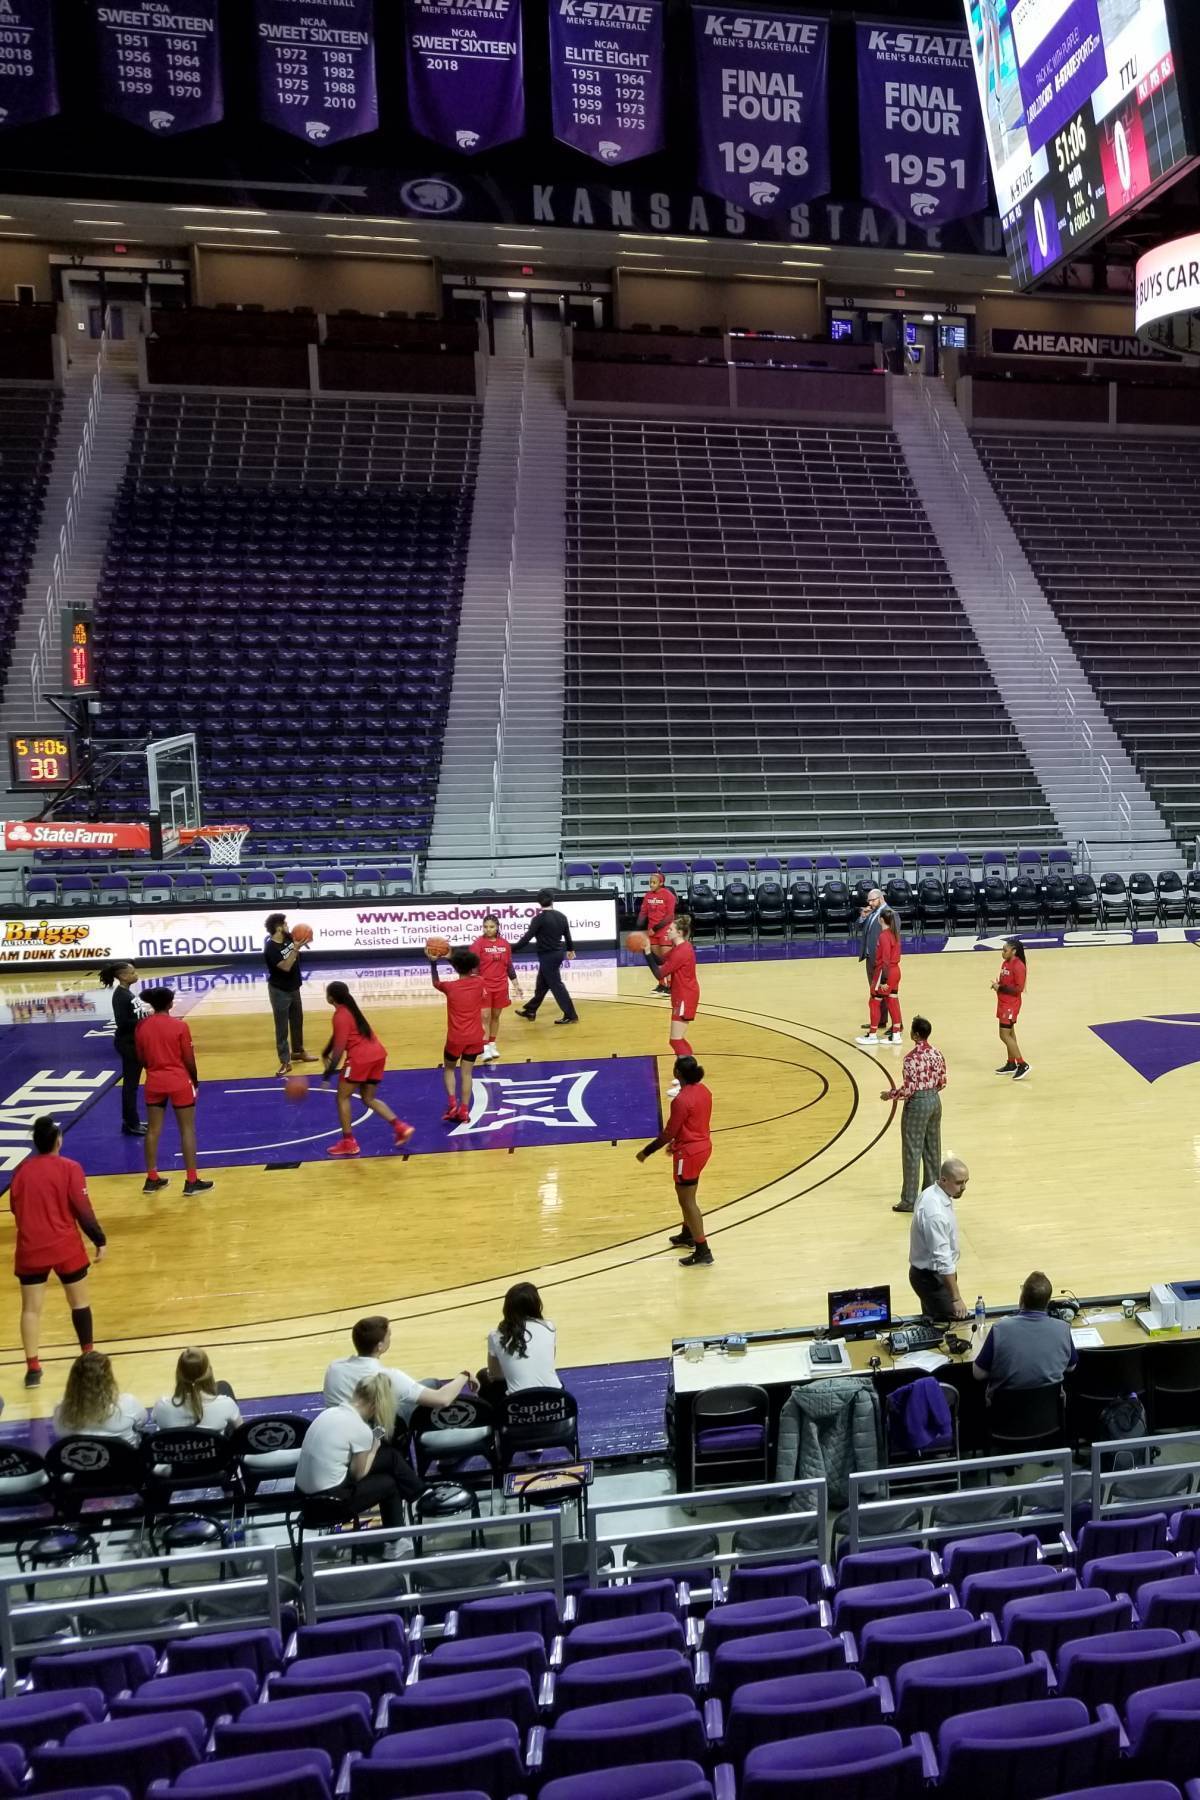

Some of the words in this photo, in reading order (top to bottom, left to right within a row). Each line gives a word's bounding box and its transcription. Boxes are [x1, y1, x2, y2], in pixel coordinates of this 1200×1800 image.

[141, 3, 170, 13] NCAA
[451, 8, 505, 19] BASKETBALL
[559, 0, 653, 23] K-STATE
[98, 8, 150, 26] SWEET
[152, 14, 214, 32] SIXTEEN
[300, 17, 327, 27] NCAA
[566, 17, 593, 26] MEN'S
[594, 20, 647, 31] BASKETBALL
[258, 23, 308, 40] SWEET
[310, 30, 369, 45] SIXTEEN
[451, 28, 477, 38] NCAA
[703, 15, 819, 45] K-STATE
[115, 33, 148, 47] 1951
[165, 38, 198, 52] 1961
[412, 35, 460, 51] SWEET
[461, 39, 516, 55] SIXTEEN
[594, 40, 619, 50] NCAA
[713, 37, 744, 49] MEN'S
[747, 40, 810, 54] BASKETBALL
[117, 49, 151, 63] 1956
[166, 54, 200, 67] 1964
[275, 47, 308, 61] 1972
[322, 51, 353, 64] 1981
[427, 58, 458, 71] 2018
[565, 46, 604, 62] ELITE
[606, 51, 649, 67] EIGHT
[877, 51, 906, 63] MEN'S
[909, 54, 969, 68] BASKETBALL
[0, 64, 33, 76] 2019
[118, 65, 152, 78] 1958
[167, 69, 201, 82] 1968
[276, 62, 308, 76] 1973
[323, 66, 355, 79] 1982
[571, 68, 601, 82] 1951
[615, 73, 645, 86] 1964
[1120, 55, 1138, 90] TTU
[119, 80, 152, 94] 1959
[168, 85, 201, 98] 1970
[276, 77, 309, 91] 1975
[324, 81, 356, 94] 1988
[572, 83, 602, 96] 1958
[615, 88, 645, 101] 1972
[722, 68, 803, 98] FINAL
[277, 92, 309, 106] 1977
[323, 96, 356, 110] 2010
[885, 81, 962, 112] FINAL
[572, 98, 602, 111] 1959
[616, 103, 645, 115] 1973
[722, 94, 802, 123] FOUR
[573, 112, 602, 126] 1961
[616, 117, 645, 130] 1975
[885, 106, 960, 136] FOUR
[1055, 114, 1087, 172] 51:06
[718, 141, 809, 176] 1948
[1114, 120, 1131, 191] 0
[885, 153, 966, 189] 1951
[1010, 166, 1033, 202] K-STATE
[1074, 190, 1084, 209] TOL
[533, 184, 746, 235] KANSAS
[1034, 197, 1047, 257] 0
[1074, 207, 1090, 232] FOULS
[16, 739, 67, 756] 51:06
[30, 758, 58, 779] 30
[357, 904, 543, 924] www.meadowlark.or
[2, 920, 90, 945] Briggs
[320, 928, 353, 937] Home
[355, 926, 390, 936] Health
[400, 923, 462, 935] Transitional
[570, 919, 601, 929] Living
[354, 937, 399, 947] Assisted
[402, 935, 427, 945] Livin
[23, 949, 56, 960] DUNK
[59, 947, 112, 959] SAVINGS
[507, 1397, 567, 1415] Capitol
[508, 1409, 567, 1426] Federal
[151, 1438, 215, 1453] Capitol
[153, 1448, 217, 1463] Federal
